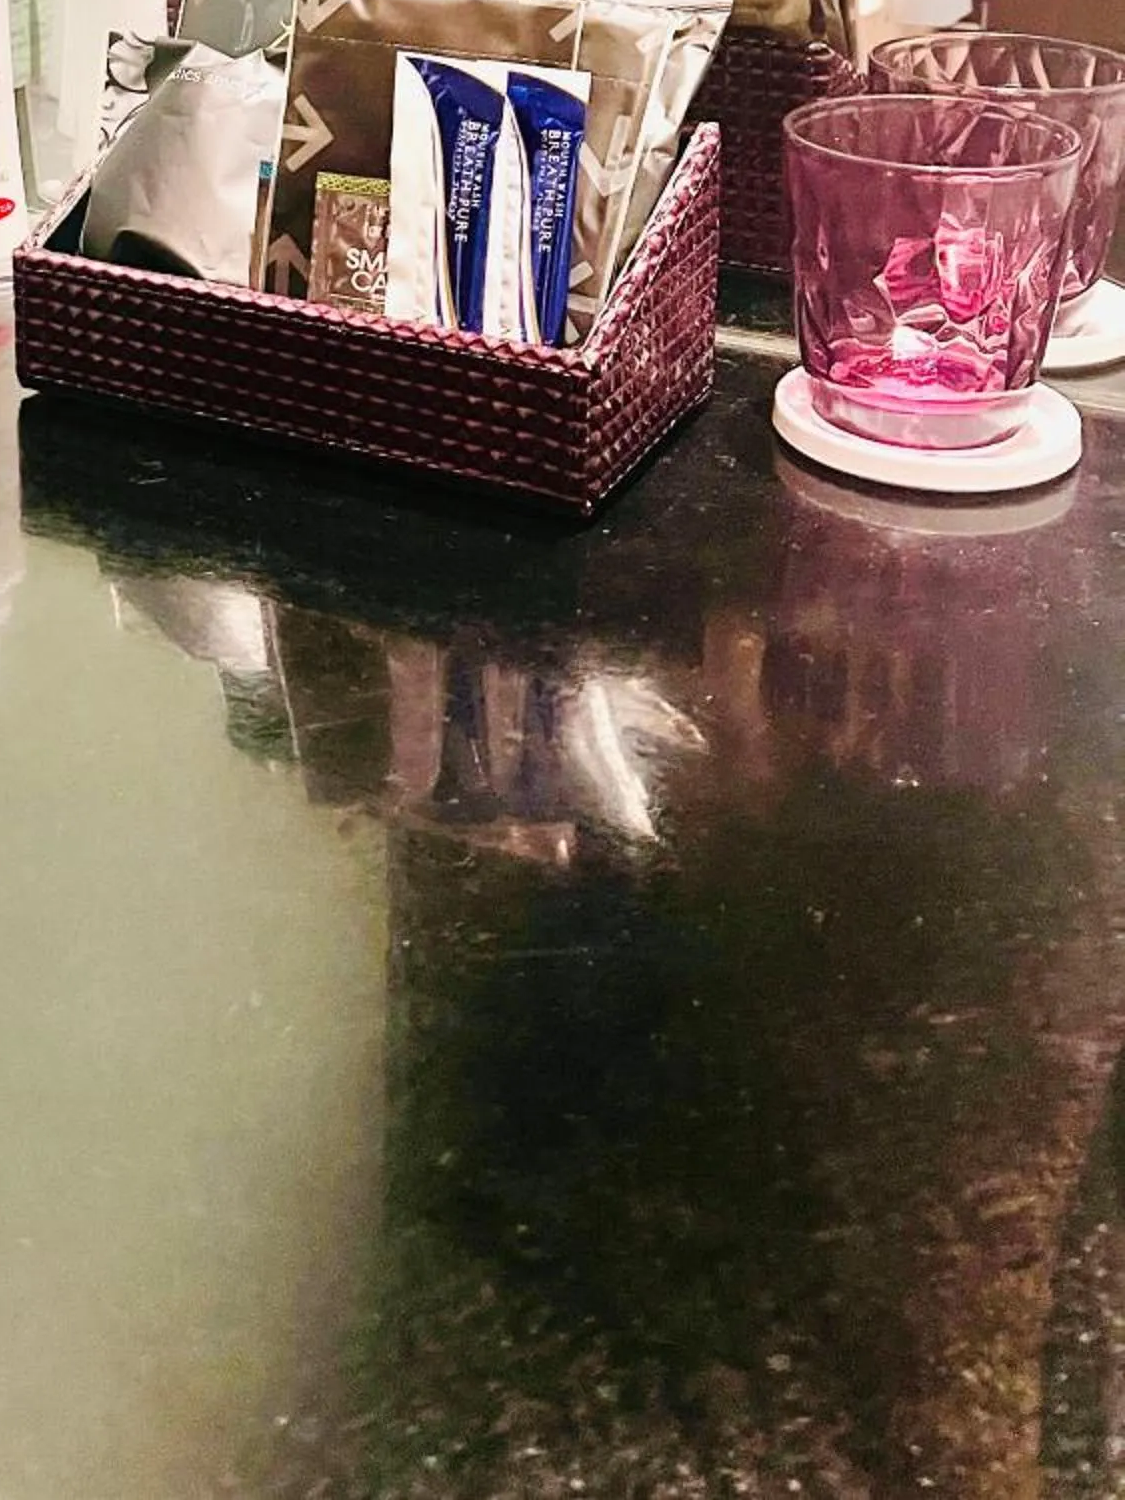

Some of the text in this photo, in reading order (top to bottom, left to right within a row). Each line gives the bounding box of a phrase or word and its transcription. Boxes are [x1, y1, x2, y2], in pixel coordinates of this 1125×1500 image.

[461, 120, 481, 191] BREATH
[544, 128, 561, 201] BREATH
[454, 198, 471, 243] PURE
[538, 206, 554, 253] PURE
[346, 246, 388, 274] SM
